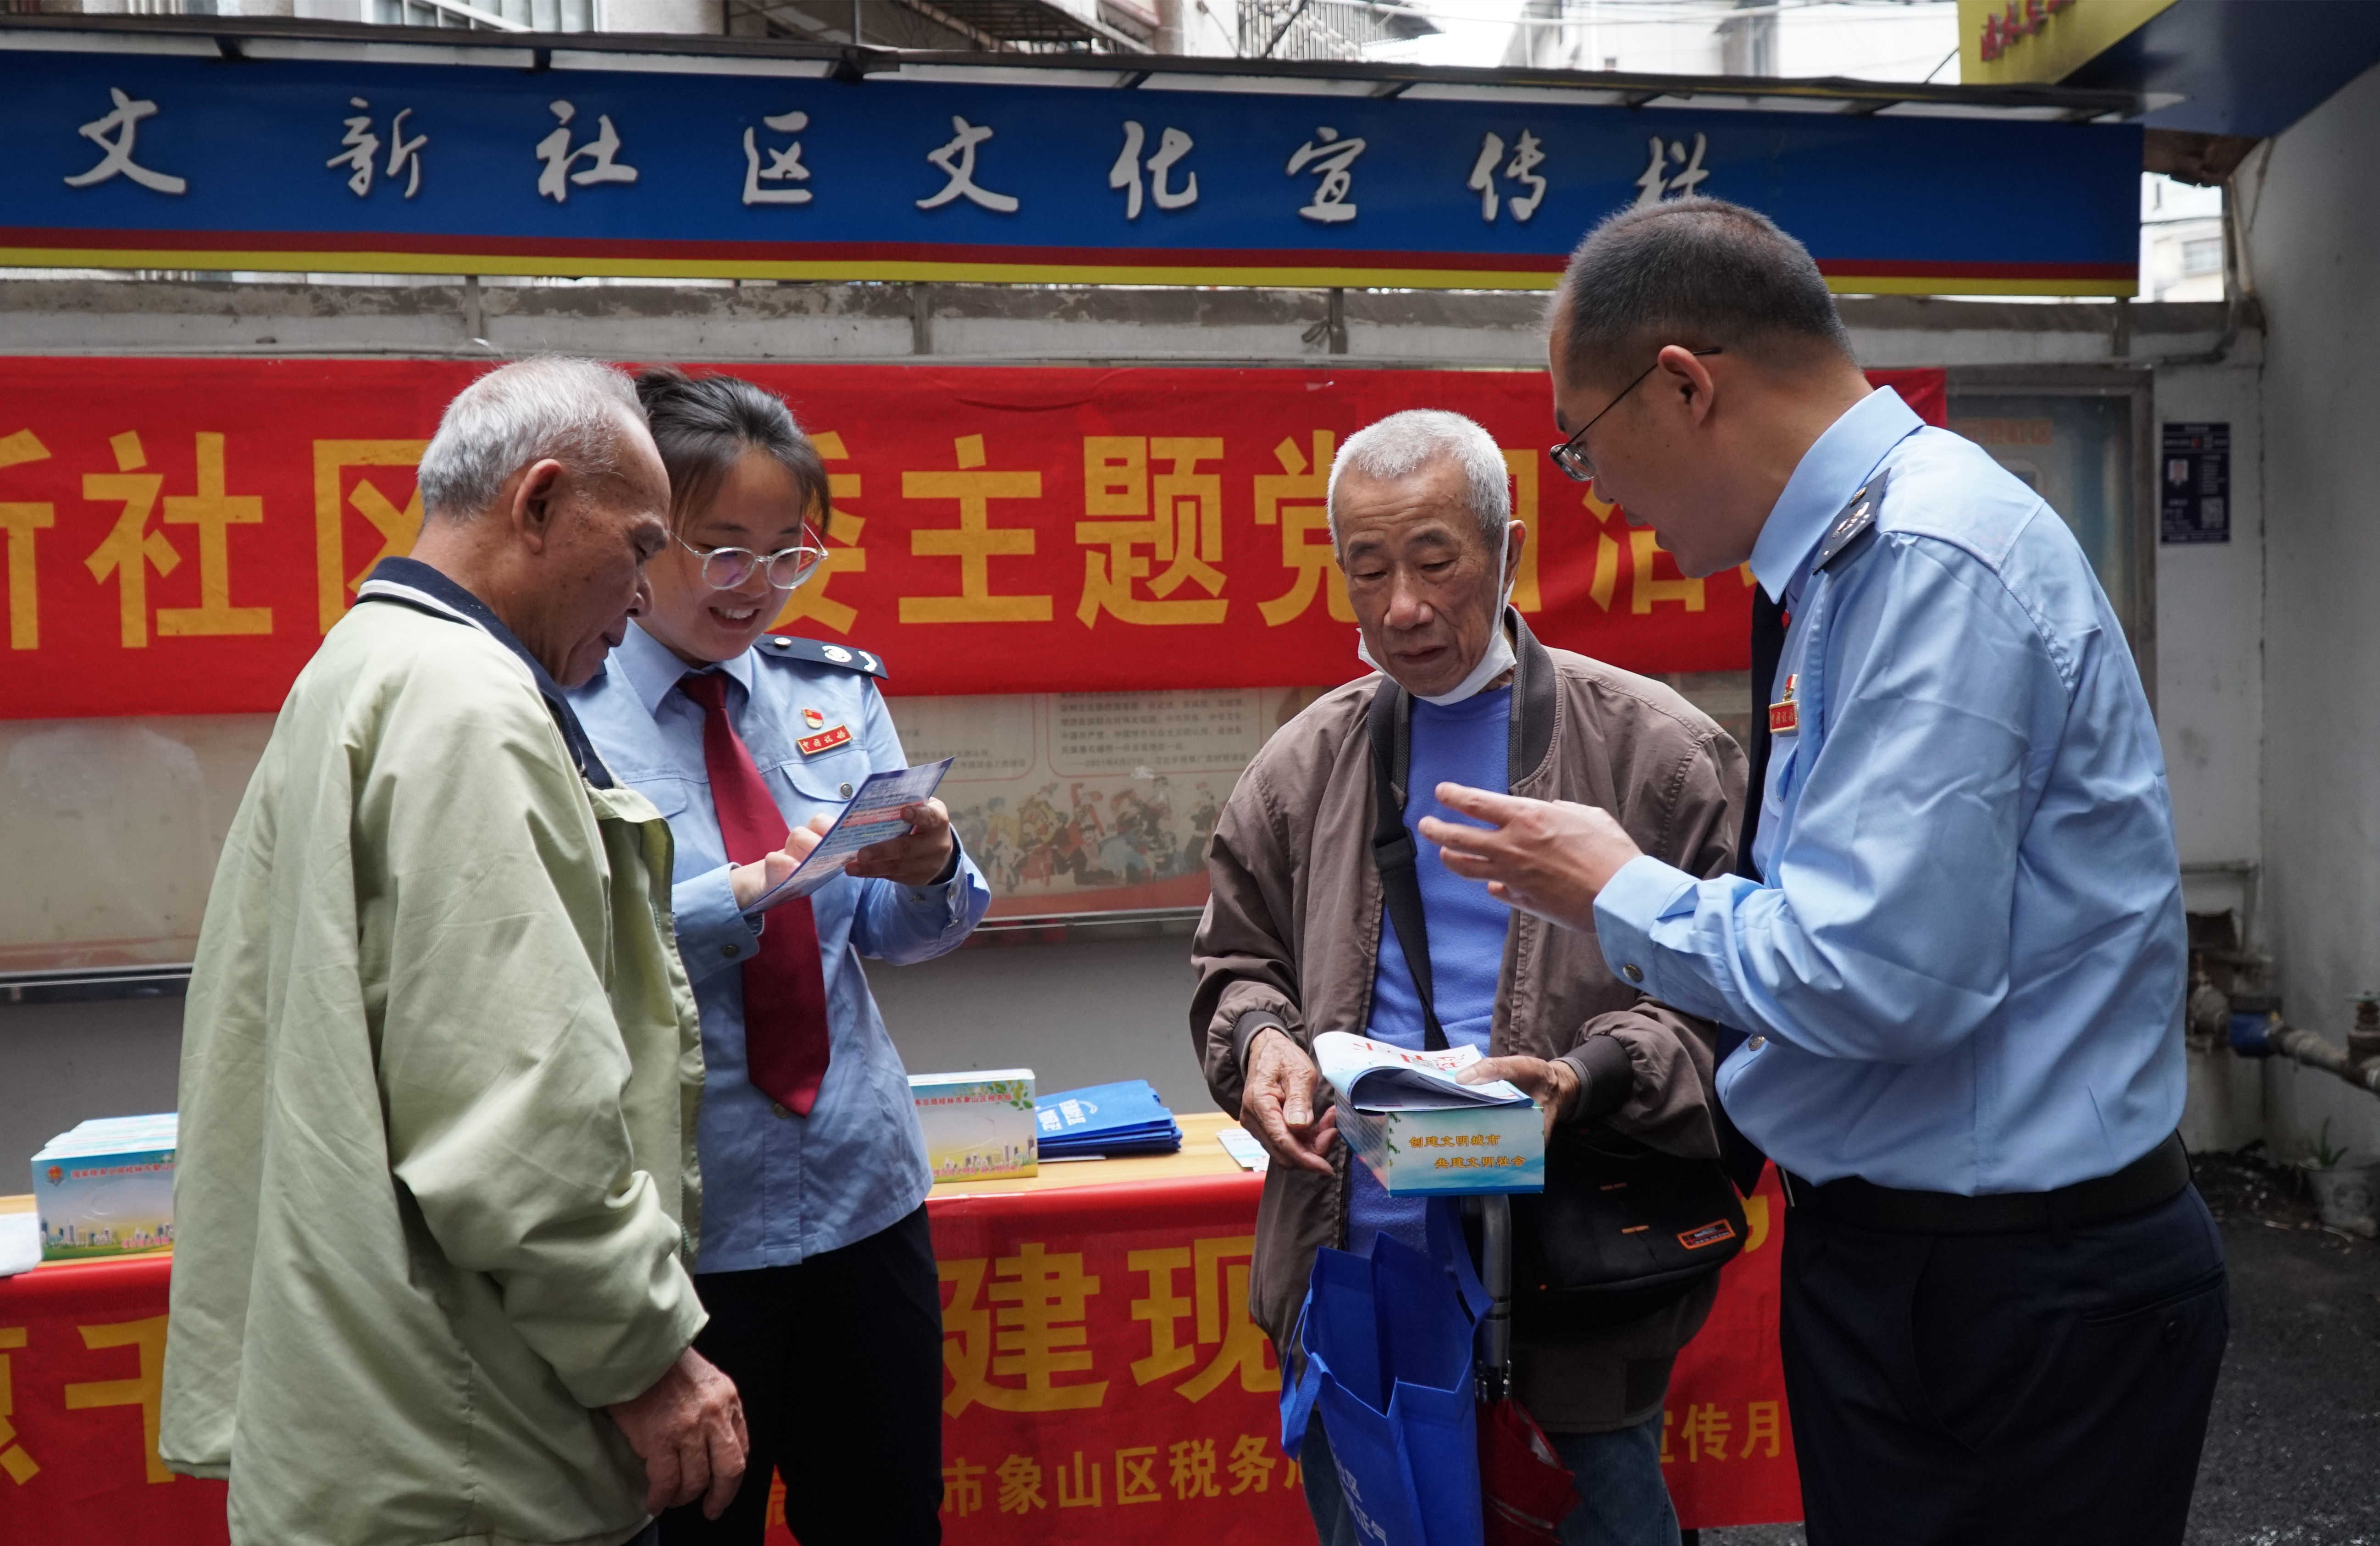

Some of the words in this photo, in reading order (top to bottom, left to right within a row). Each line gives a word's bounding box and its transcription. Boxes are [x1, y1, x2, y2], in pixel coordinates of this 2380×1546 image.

[1409, 1134, 1500, 1148] 创建文明城市
[1434, 1155, 1526, 1169] 共建文明社会
[1659, 1400, 1781, 1463] 传月
